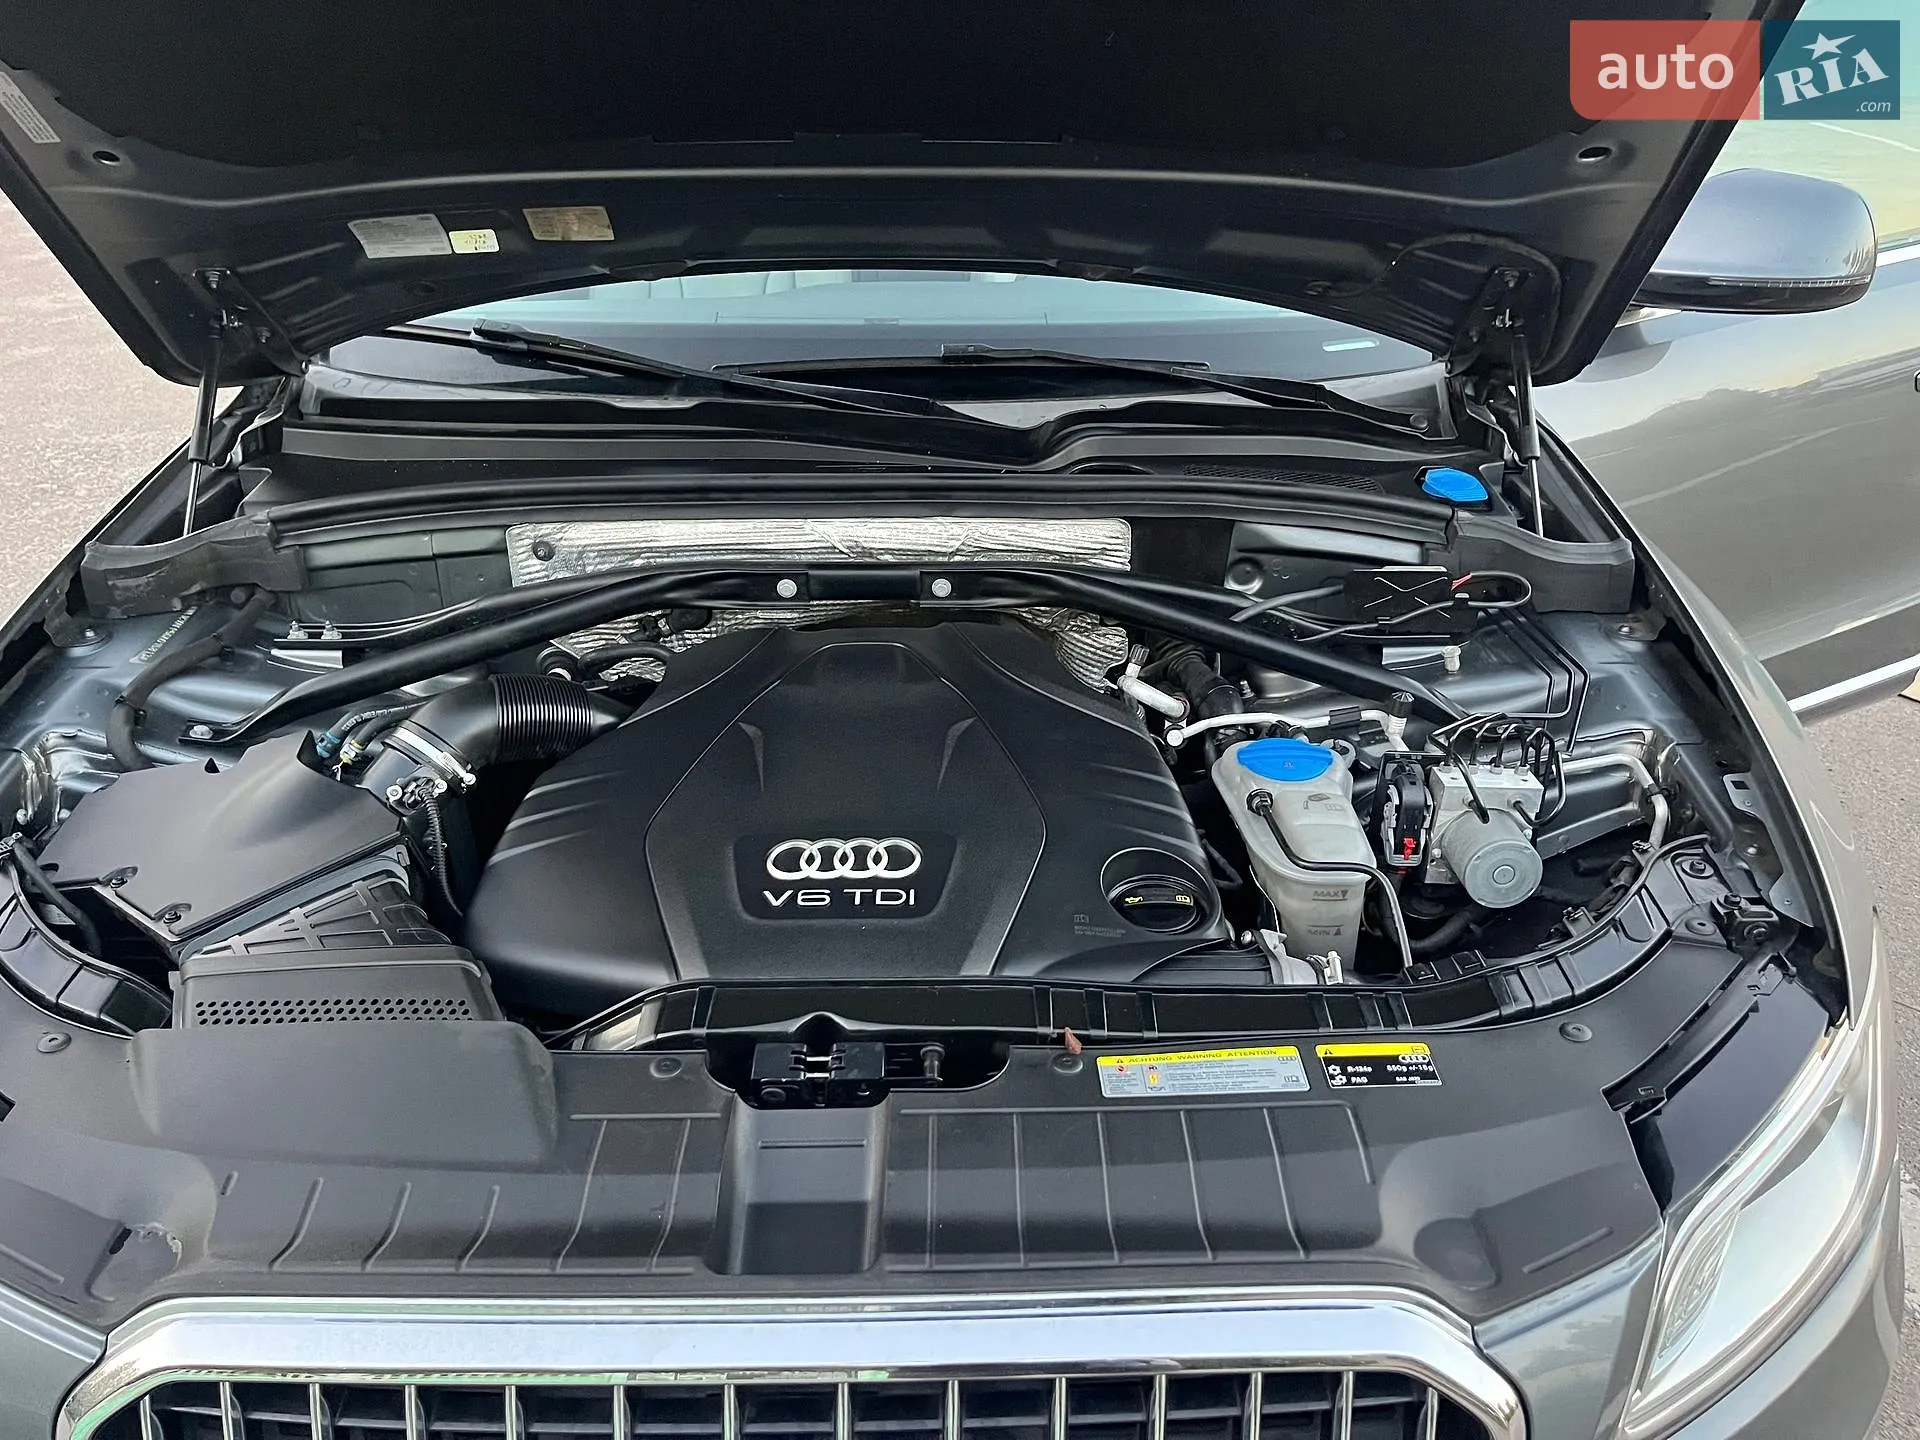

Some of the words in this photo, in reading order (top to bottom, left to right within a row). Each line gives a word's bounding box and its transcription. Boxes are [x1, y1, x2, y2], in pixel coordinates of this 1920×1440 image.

[762, 889, 831, 907] V6
[843, 889, 915, 906] TDI
[1177, 1052, 1222, 1060] WARNING
[1227, 1049, 1277, 1057] ATTENTION
